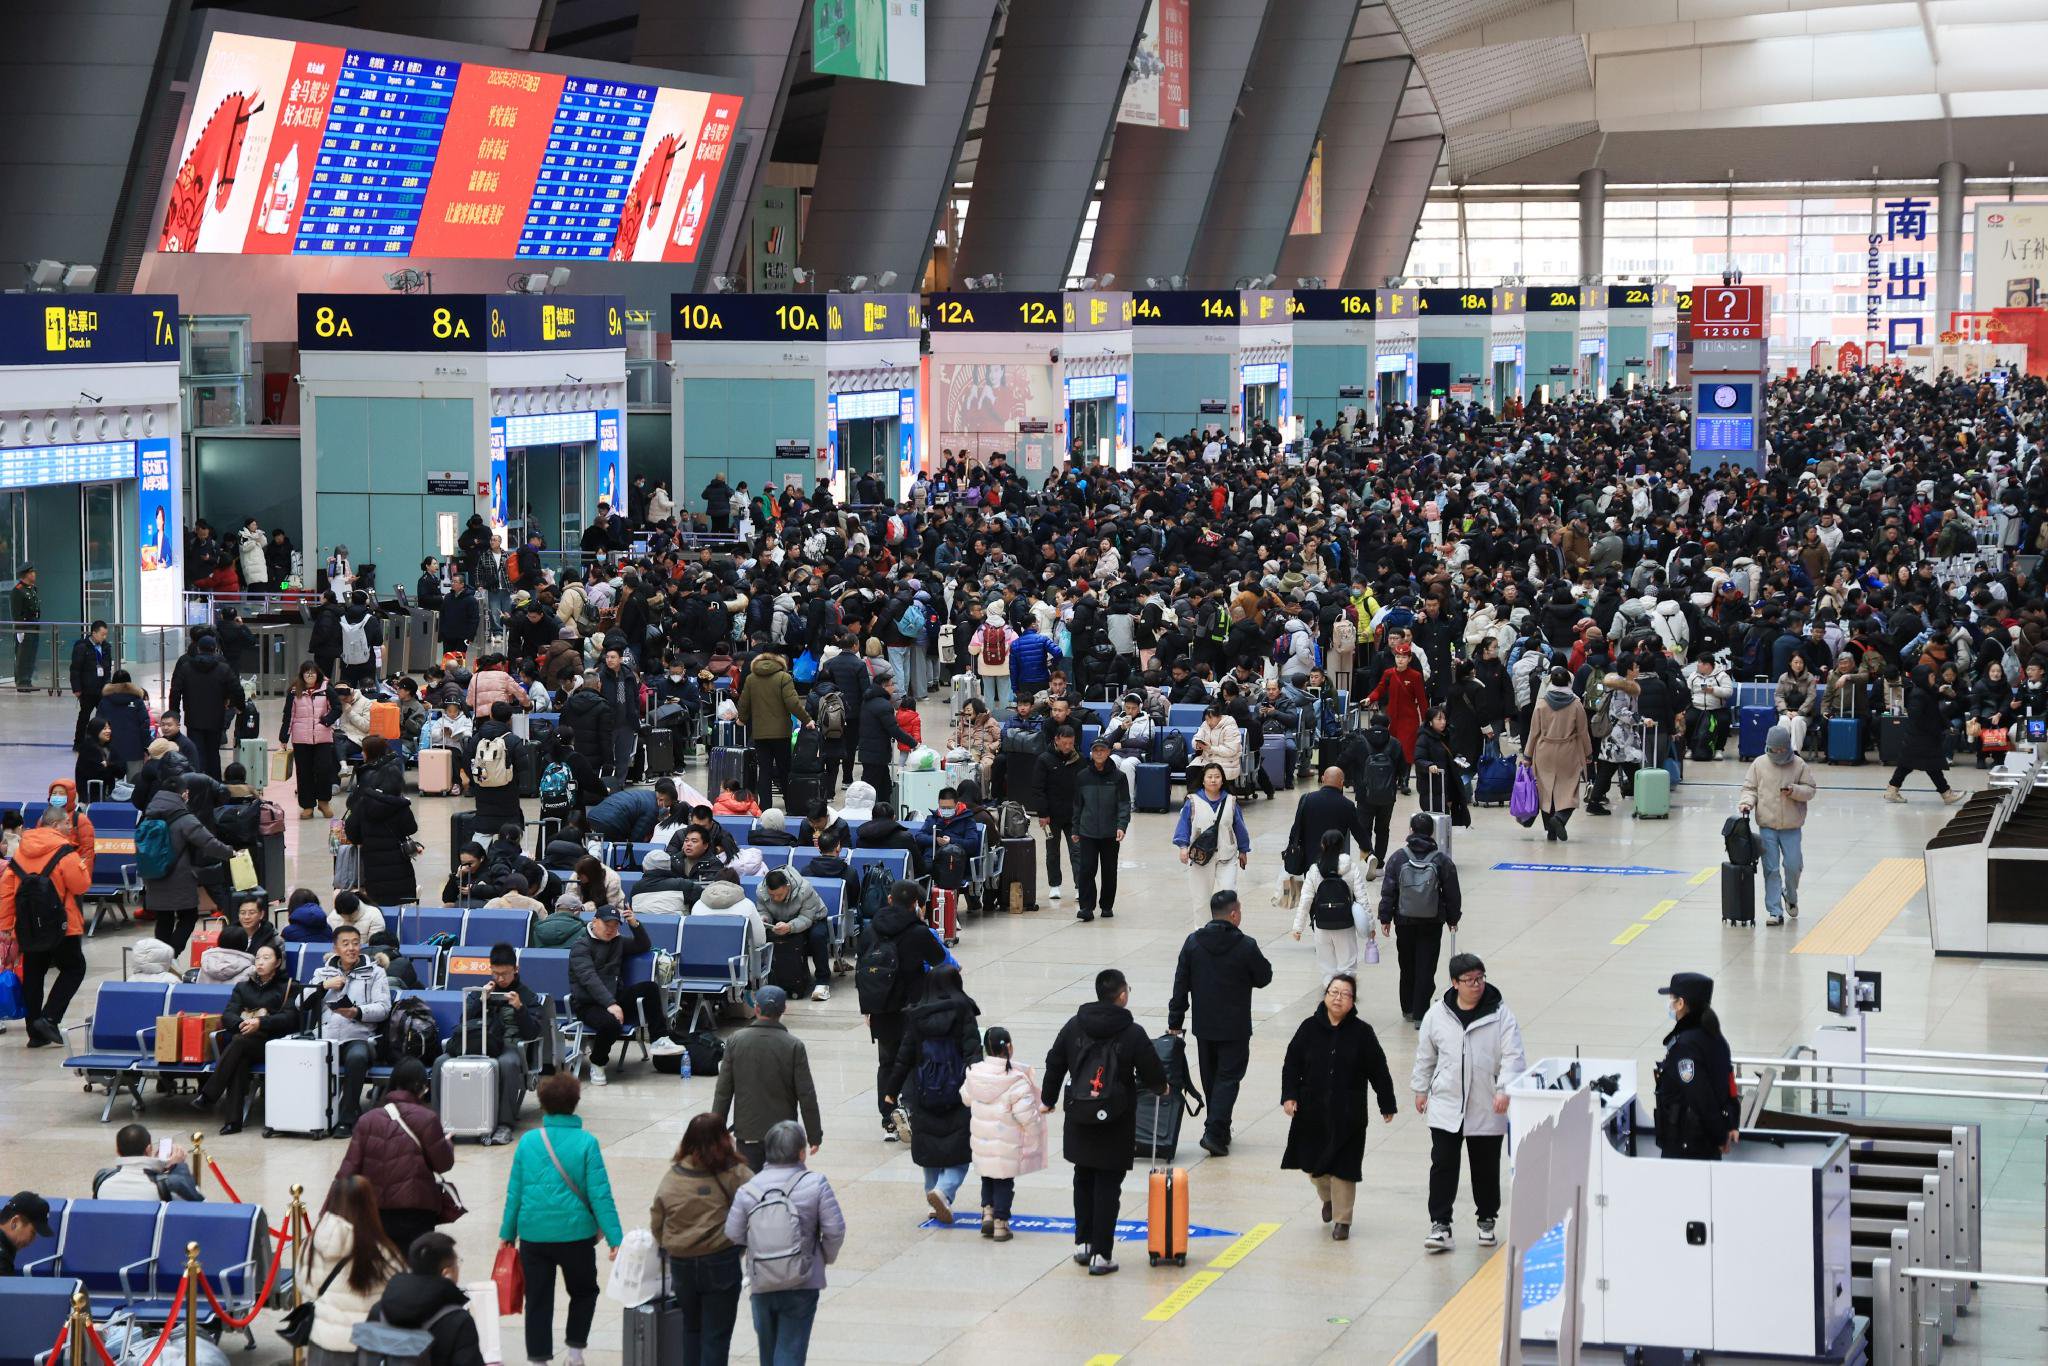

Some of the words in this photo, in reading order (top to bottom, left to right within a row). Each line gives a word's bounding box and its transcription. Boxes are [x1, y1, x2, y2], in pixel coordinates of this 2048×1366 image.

[346, 54, 359, 66] 车次
[289, 79, 329, 103] 金马贺岁
[282, 104, 323, 127] 好水旺财
[488, 105, 518, 127] 平安春运
[702, 123, 729, 141] 金马贺岁
[478, 137, 509, 160] 有序春运
[696, 142, 724, 160] 好水旺财
[468, 170, 499, 192] 温馨春运
[445, 202, 504, 224] 让旅客体验更美好
[2002, 237, 2048, 260] 八子补
[1868, 234, 1882, 289] South
[1885, 198, 1930, 354] 南出口
[1341, 296, 1370, 313] 16A
[1461, 295, 1486, 309] 18A
[1551, 293, 1576, 306] 20A
[1626, 291, 1649, 303] 22A
[556, 307, 575, 326] 检票口
[680, 305, 723, 329] 10A
[776, 306, 819, 330] 10A
[828, 306, 842, 330] 10A
[908, 306, 920, 328] 11A
[937, 302, 974, 323] 12A
[1020, 303, 1056, 324] 12A
[1132, 299, 1161, 318] 14A
[1201, 299, 1234, 318] 14A
[1867, 297, 1882, 330] Exit
[68, 310, 97, 332] 检票口
[152, 311, 173, 345] 7A
[316, 307, 353, 337] 8A
[432, 308, 470, 338] 8A
[491, 308, 506, 338] 8A
[609, 308, 622, 335] 9A
[1704, 328, 1750, 336] 12306
[68, 337, 85, 348] Check
[86, 338, 91, 348] in
